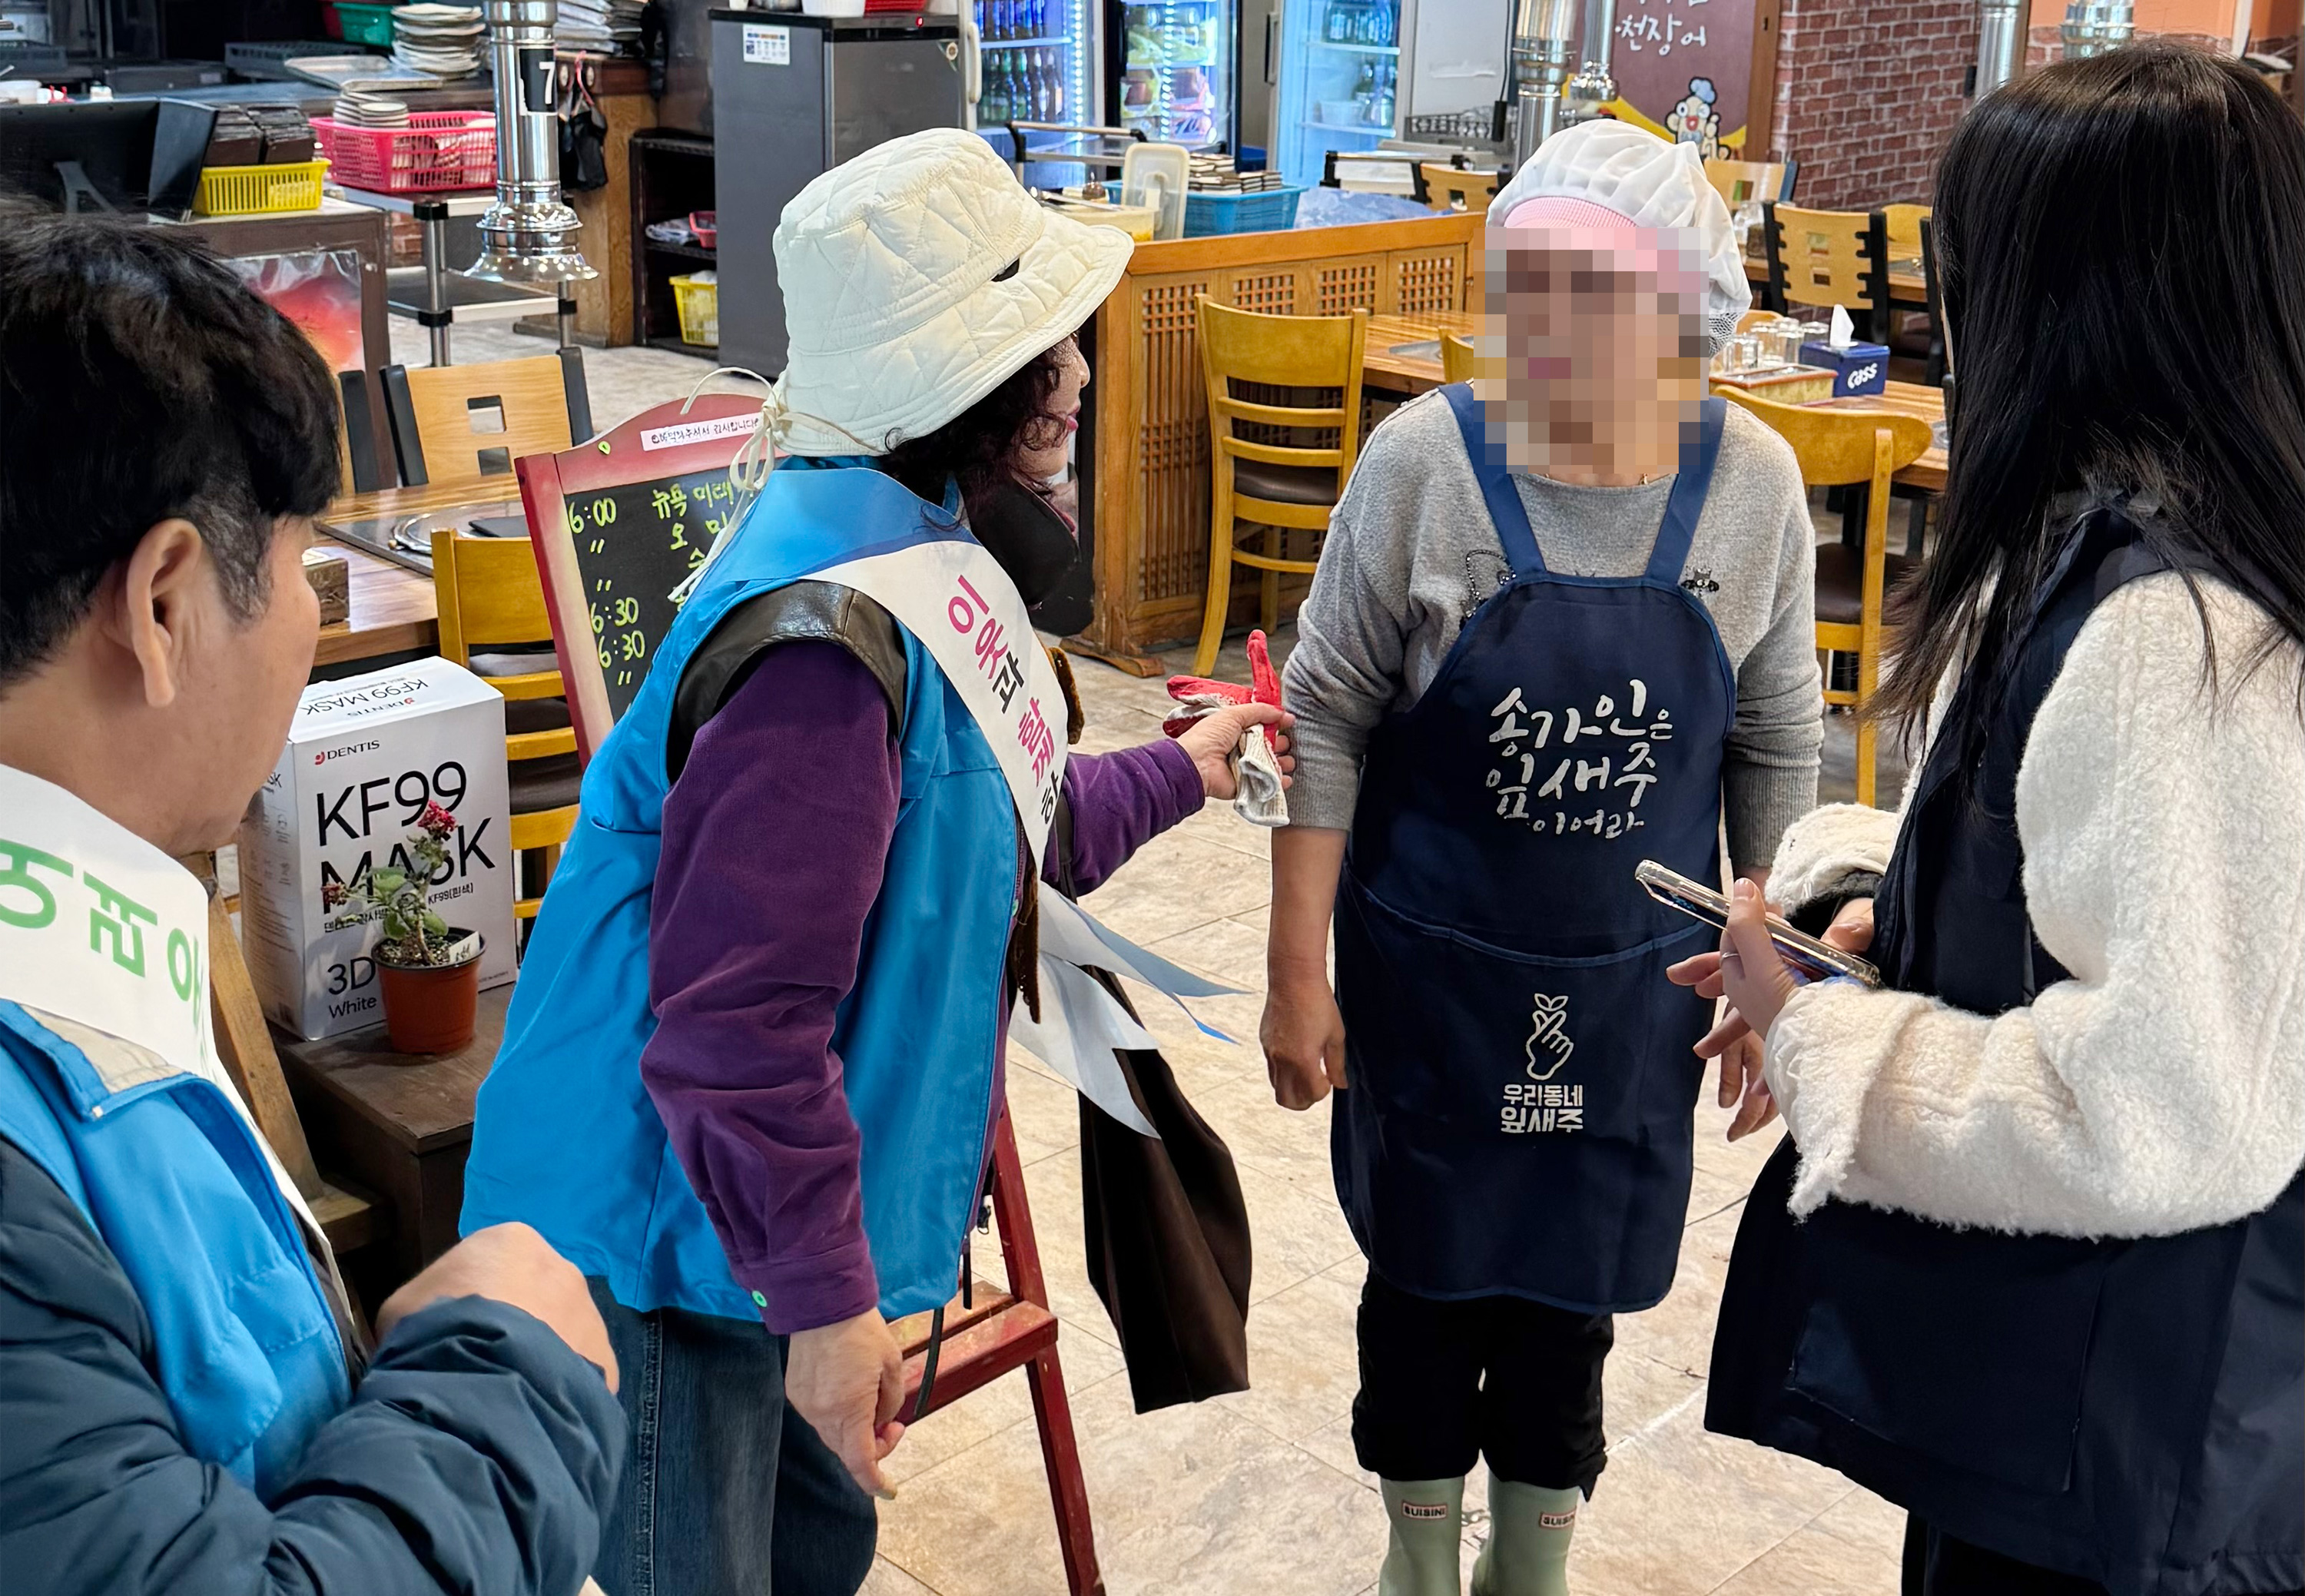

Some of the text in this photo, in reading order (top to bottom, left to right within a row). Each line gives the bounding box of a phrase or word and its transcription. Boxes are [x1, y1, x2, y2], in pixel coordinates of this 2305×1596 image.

[539, 61, 556, 105] 7
[569, 497, 616, 533] 6:00
[590, 597, 638, 634] 6:30
[599, 630, 645, 669] 6:30
[372, 679, 429, 698] KF99
[948, 575, 1024, 715] 이웃과
[1018, 697, 1055, 788] 함께
[300, 693, 369, 715] MASK
[1489, 679, 1673, 757] 송가인은
[327, 740, 380, 760] DENTIS
[1485, 742, 1658, 820] 잎새주
[317, 761, 466, 847] KF99
[327, 956, 376, 995] 3D
[328, 997, 377, 1020] White
[1503, 1083, 1583, 1107] 우리동네
[1501, 1107, 1584, 1133] 잎새주
